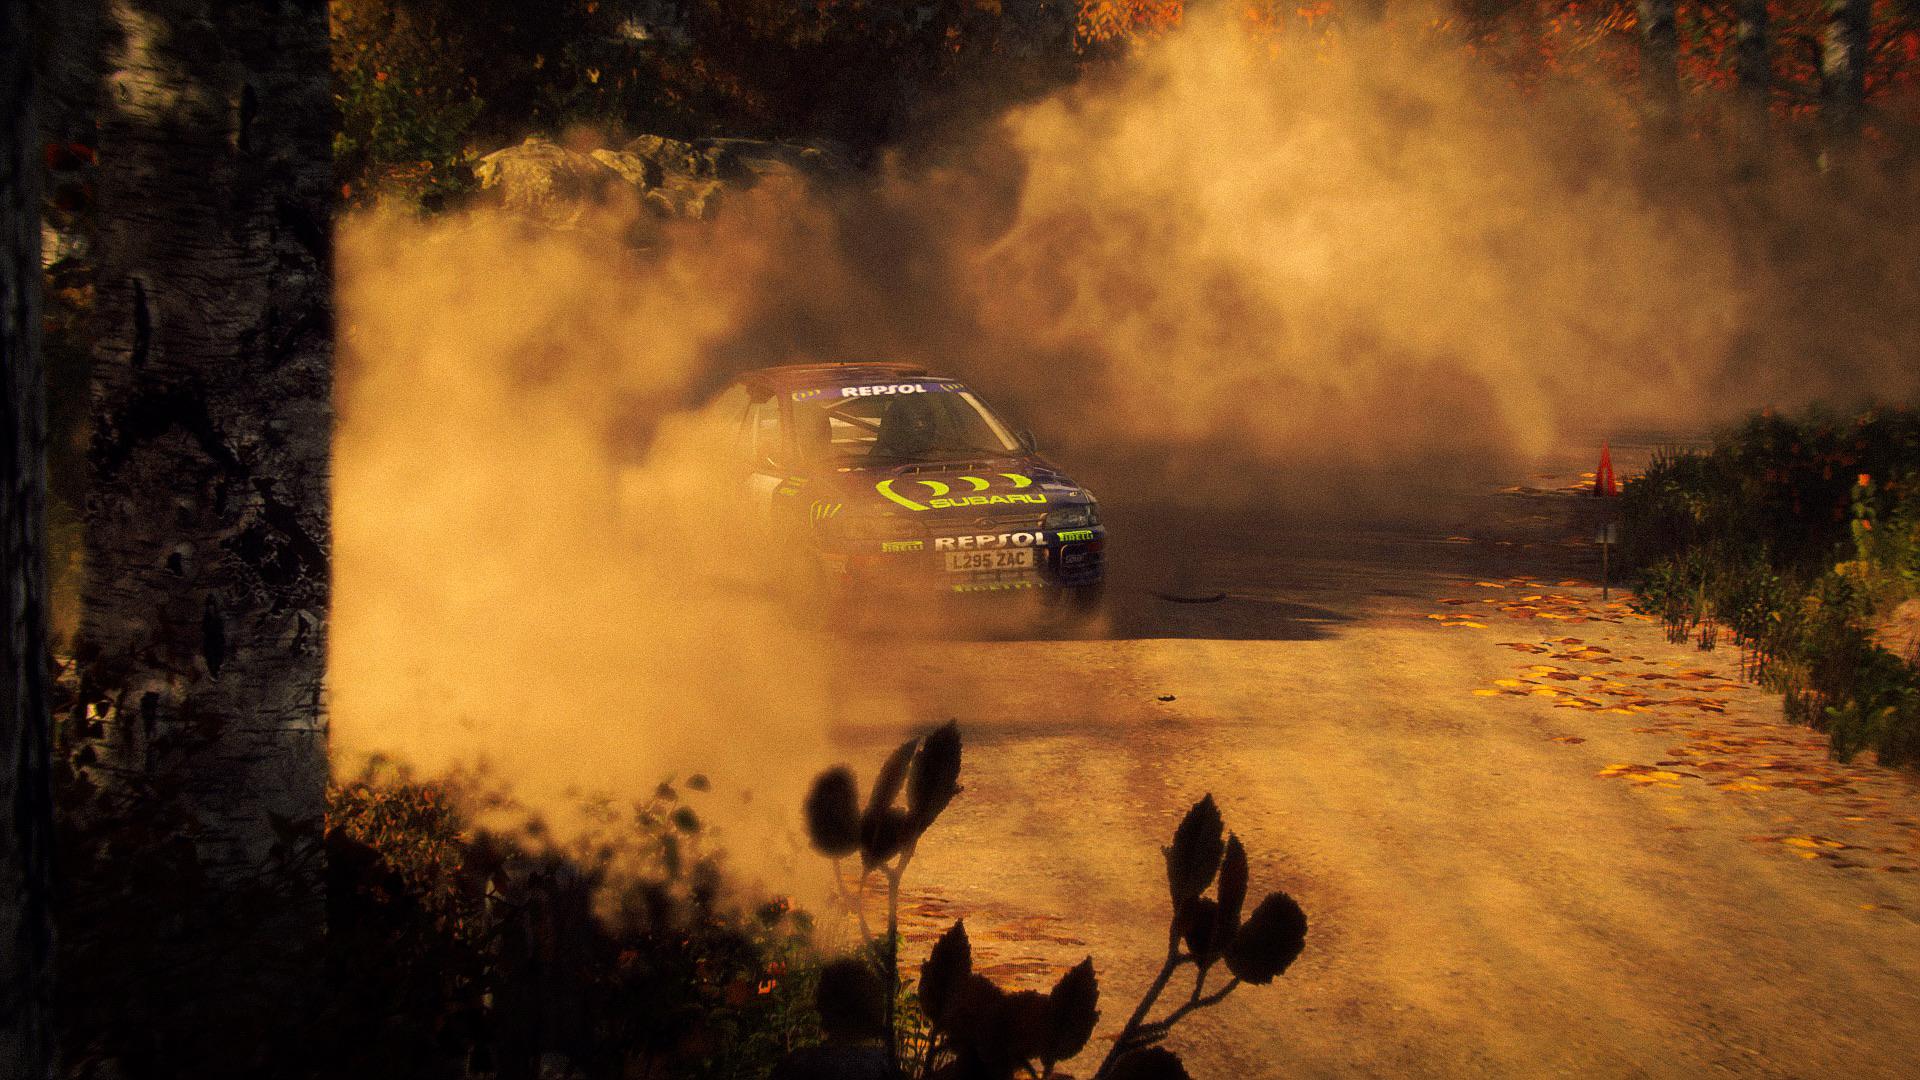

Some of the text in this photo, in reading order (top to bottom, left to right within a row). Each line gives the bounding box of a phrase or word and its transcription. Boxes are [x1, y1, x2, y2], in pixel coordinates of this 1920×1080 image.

[841, 384, 927, 398] REPSOL
[929, 493, 1048, 509] SUBARU
[935, 531, 1049, 551] REPSOL
[1056, 530, 1094, 542] PIRELLI
[953, 551, 1025, 570] L295 ZAC
